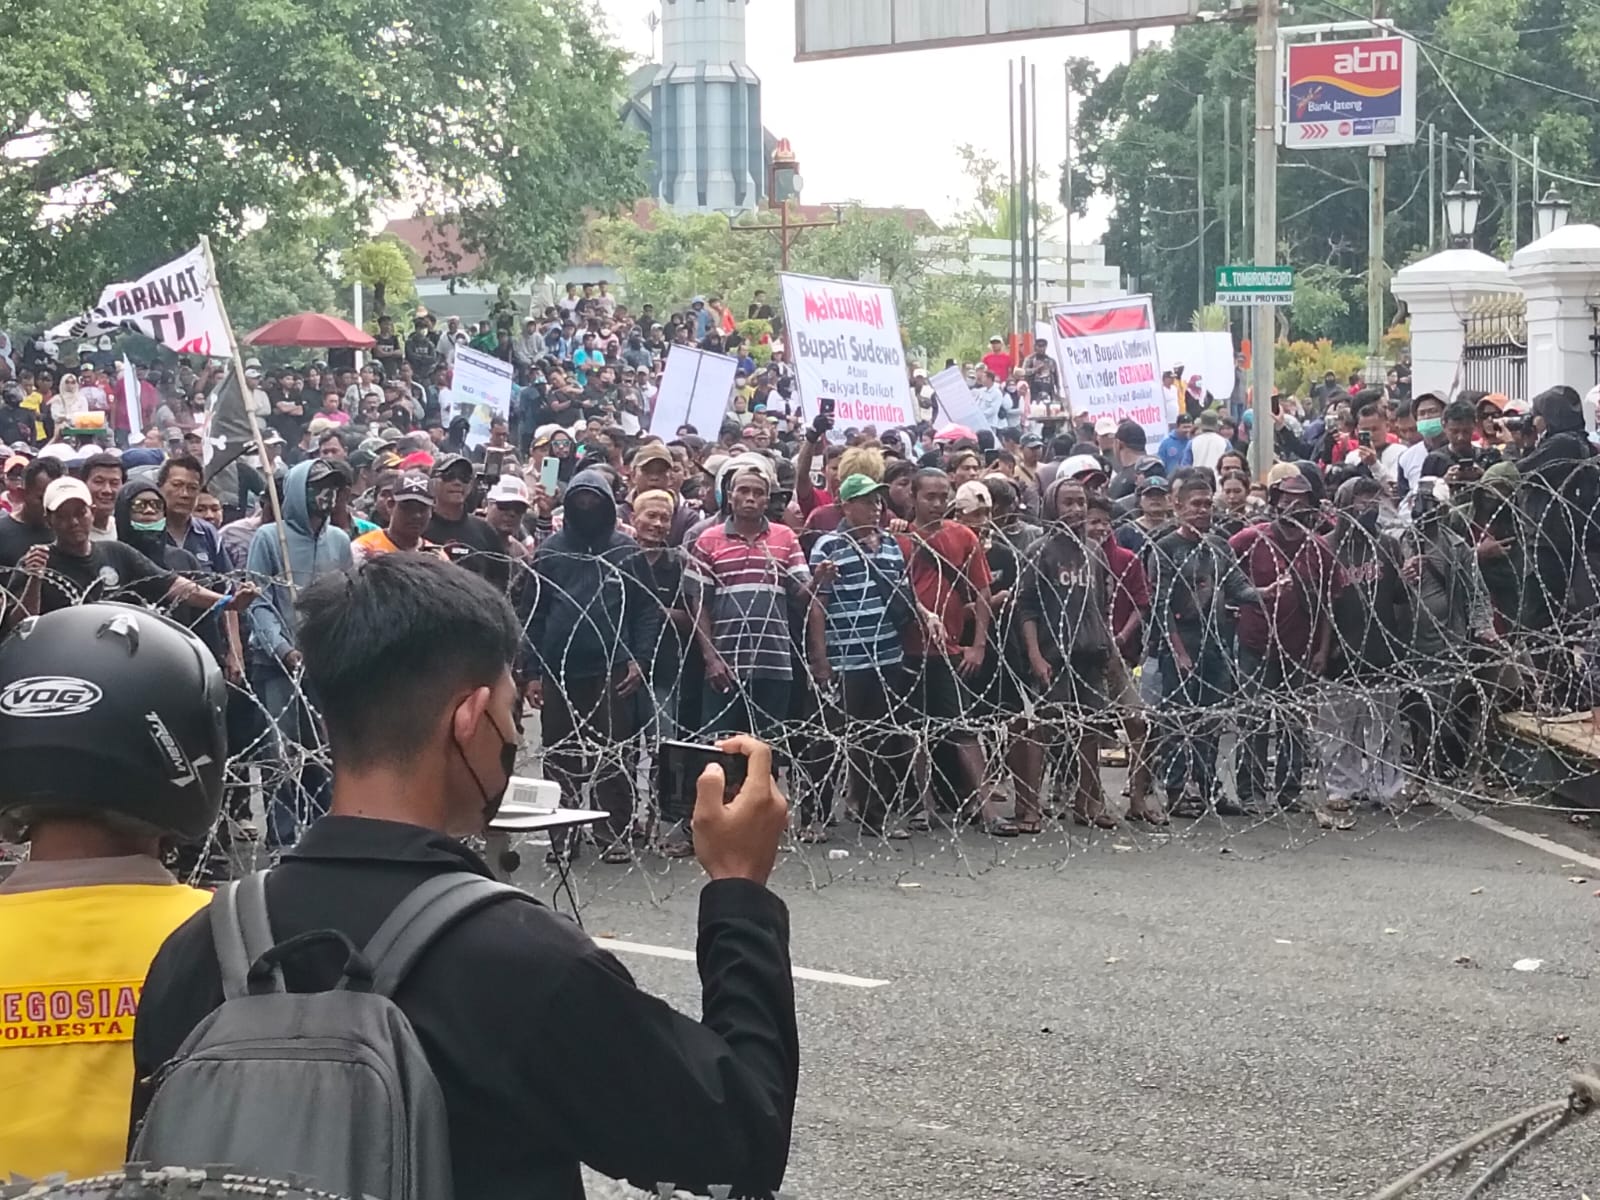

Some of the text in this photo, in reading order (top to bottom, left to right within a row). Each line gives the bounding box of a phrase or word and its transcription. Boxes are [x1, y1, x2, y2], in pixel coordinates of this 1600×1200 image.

[1334, 46, 1398, 74] atm
[1308, 100, 1362, 112] Bank Jateng
[1226, 294, 1292, 303] JALAN PROVINSI
[797, 332, 900, 366] Bupati Sudewo
[847, 367, 868, 377] Atau
[821, 379, 894, 398] Rakyat Boikot
[856, 399, 905, 423] Gerindra
[13, 689, 86, 704] VOG
[0, 987, 143, 1023] EGOSIA
